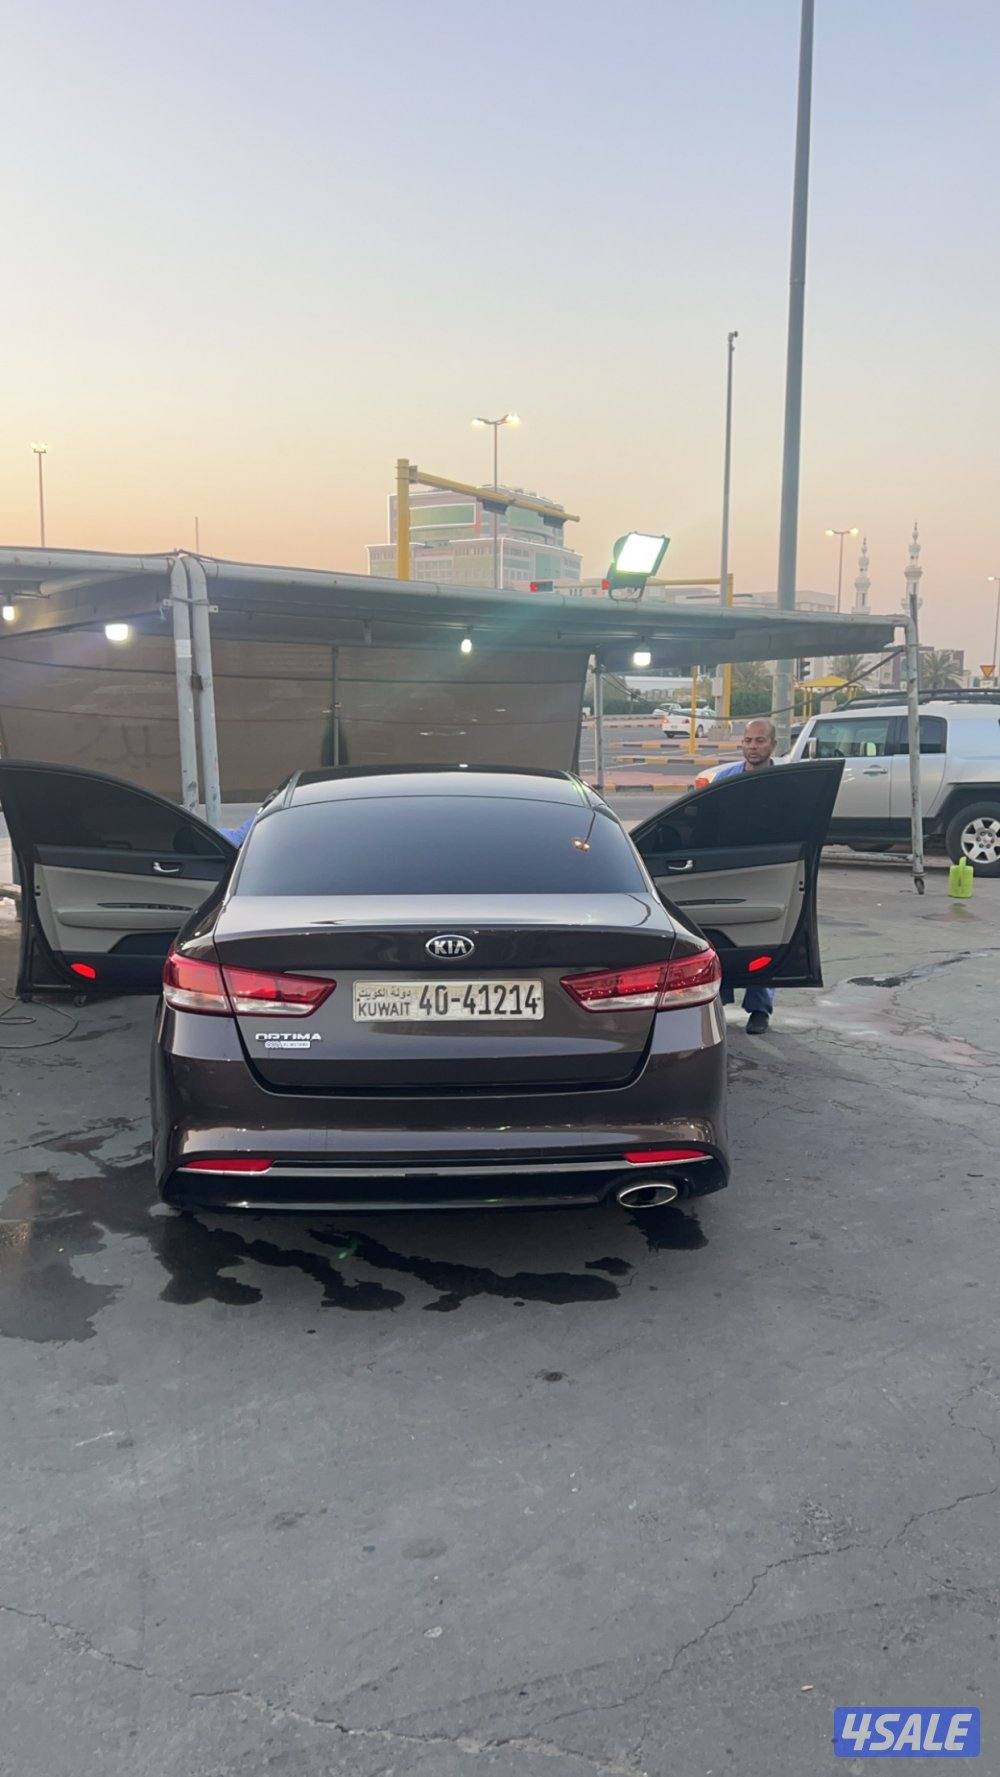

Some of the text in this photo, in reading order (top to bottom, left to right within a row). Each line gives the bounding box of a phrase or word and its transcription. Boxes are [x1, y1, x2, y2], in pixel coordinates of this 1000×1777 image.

[434, 940, 467, 955] KIA
[358, 986, 411, 999] دولة الكويت
[419, 984, 538, 1016] 40-41214
[358, 1002, 411, 1016] KUWAIT
